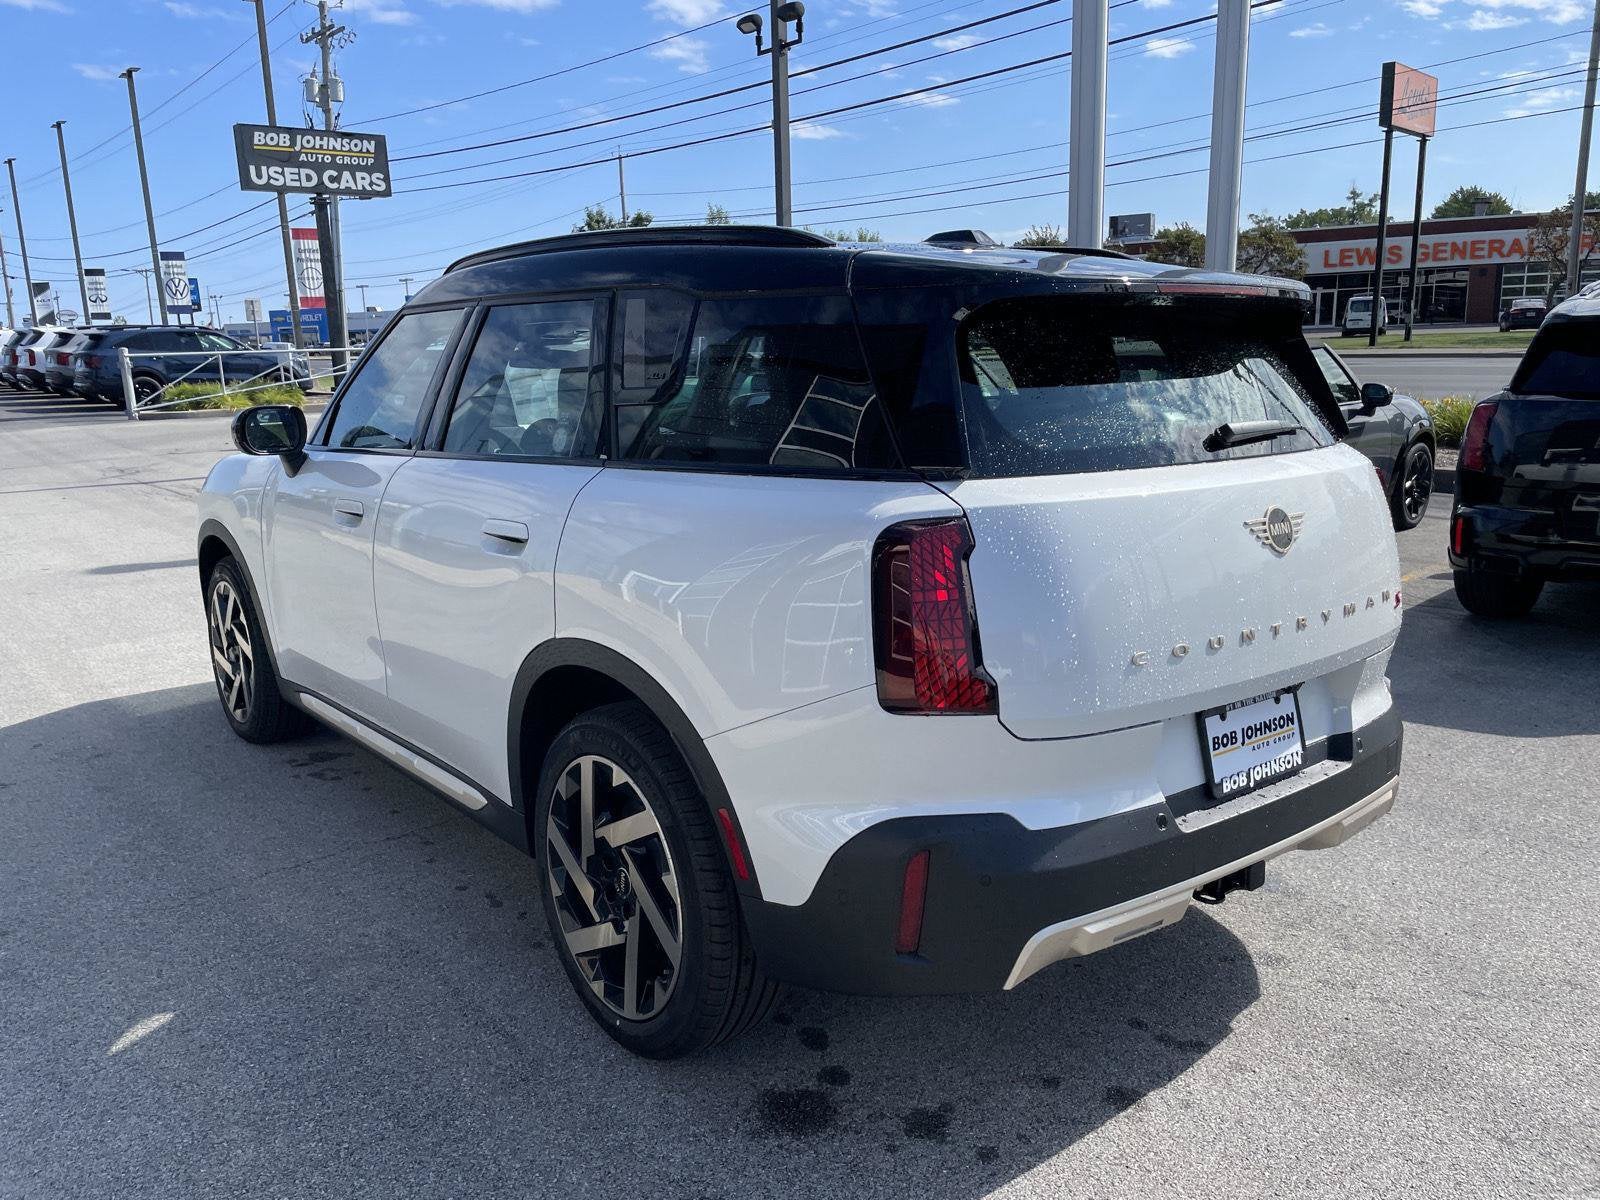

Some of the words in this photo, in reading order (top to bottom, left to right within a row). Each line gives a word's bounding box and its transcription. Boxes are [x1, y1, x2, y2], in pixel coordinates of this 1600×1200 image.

[253, 131, 291, 147] BOB
[293, 134, 375, 153] JOHNSON
[299, 153, 331, 163] AUTO
[336, 156, 374, 166] GROUP
[249, 165, 318, 188] USED
[323, 169, 387, 192] CARS
[1323, 244, 1404, 269] LEWS
[1269, 522, 1291, 536] MINI
[1212, 730, 1238, 751] BOB
[1241, 712, 1295, 746] JOHNSON
[1252, 742, 1270, 752] AUTO
[1274, 732, 1295, 744] GROUP
[1222, 770, 1248, 793] BOB
[1249, 750, 1304, 788] JOHNSON
